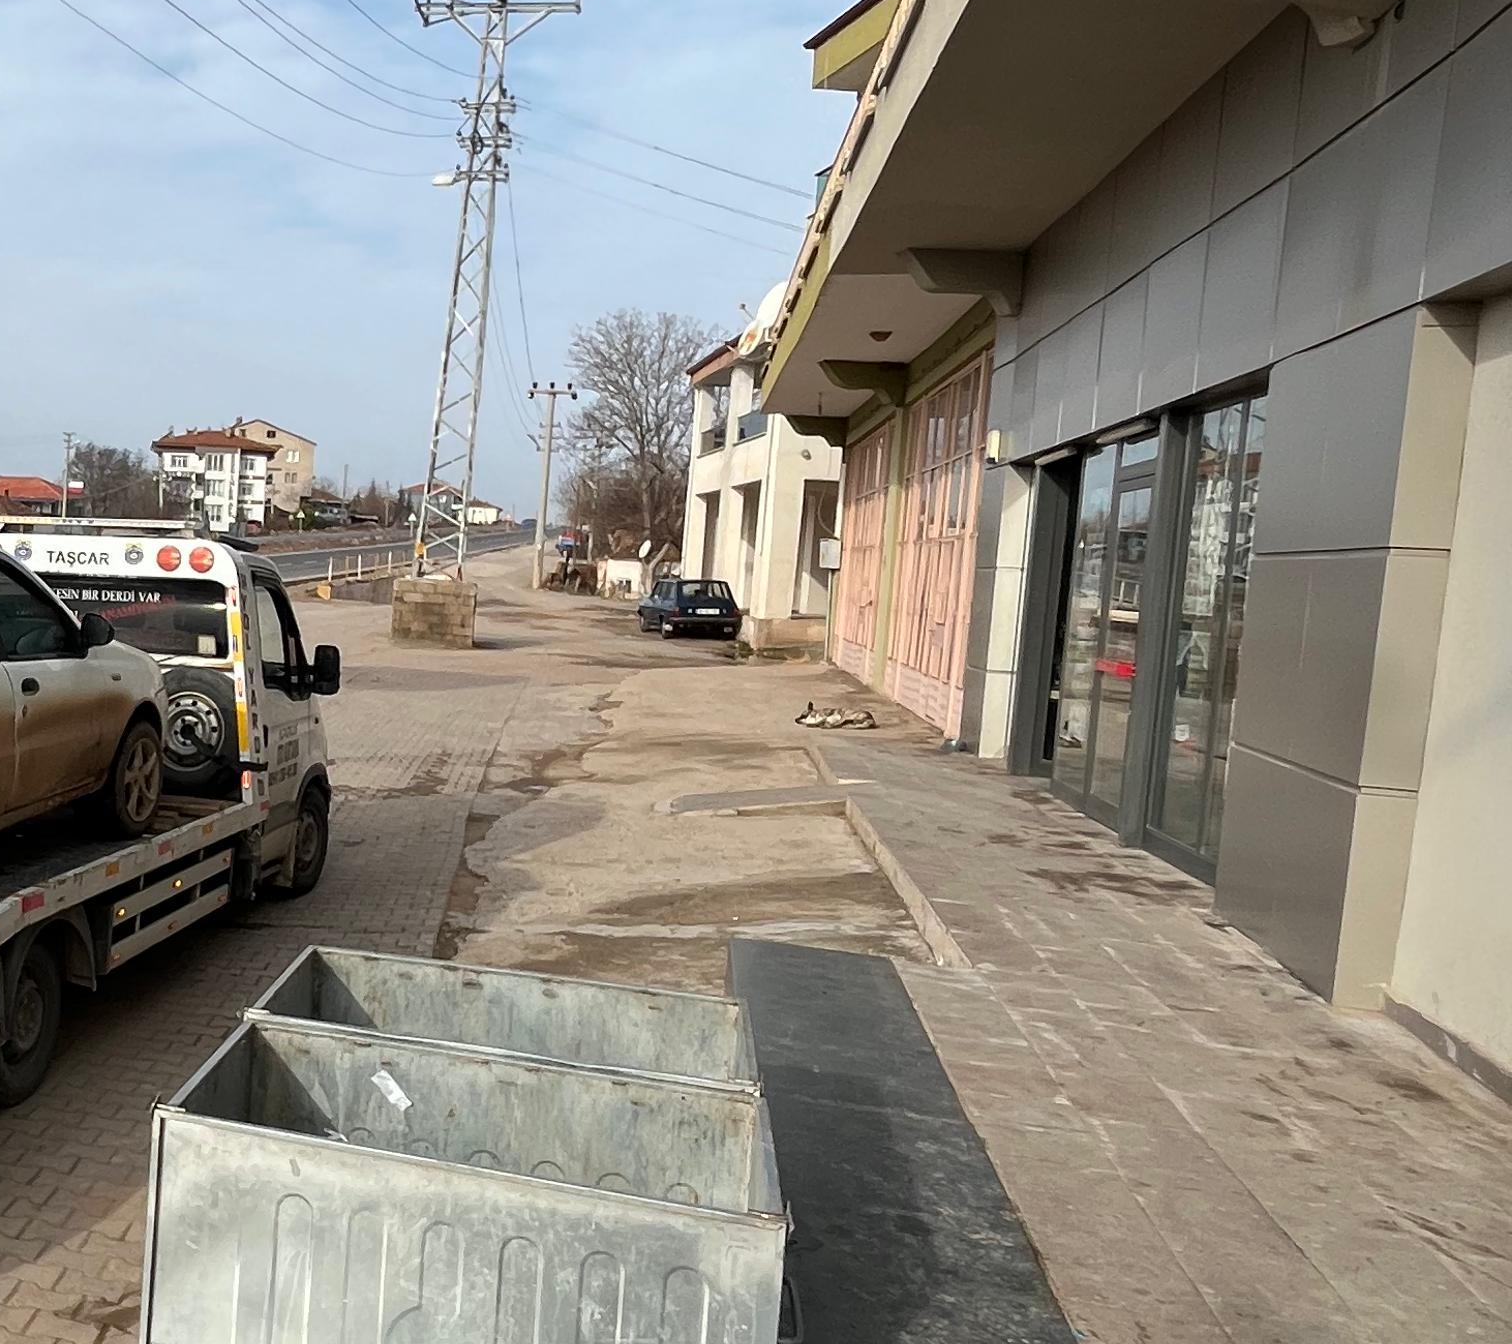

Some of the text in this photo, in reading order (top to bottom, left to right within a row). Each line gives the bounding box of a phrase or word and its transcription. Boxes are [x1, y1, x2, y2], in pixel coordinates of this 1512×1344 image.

[46, 550, 110, 567] TAŞCAR
[82, 587, 99, 601] BİR
[101, 589, 136, 603] DERDİ
[138, 591, 161, 604] VAR
